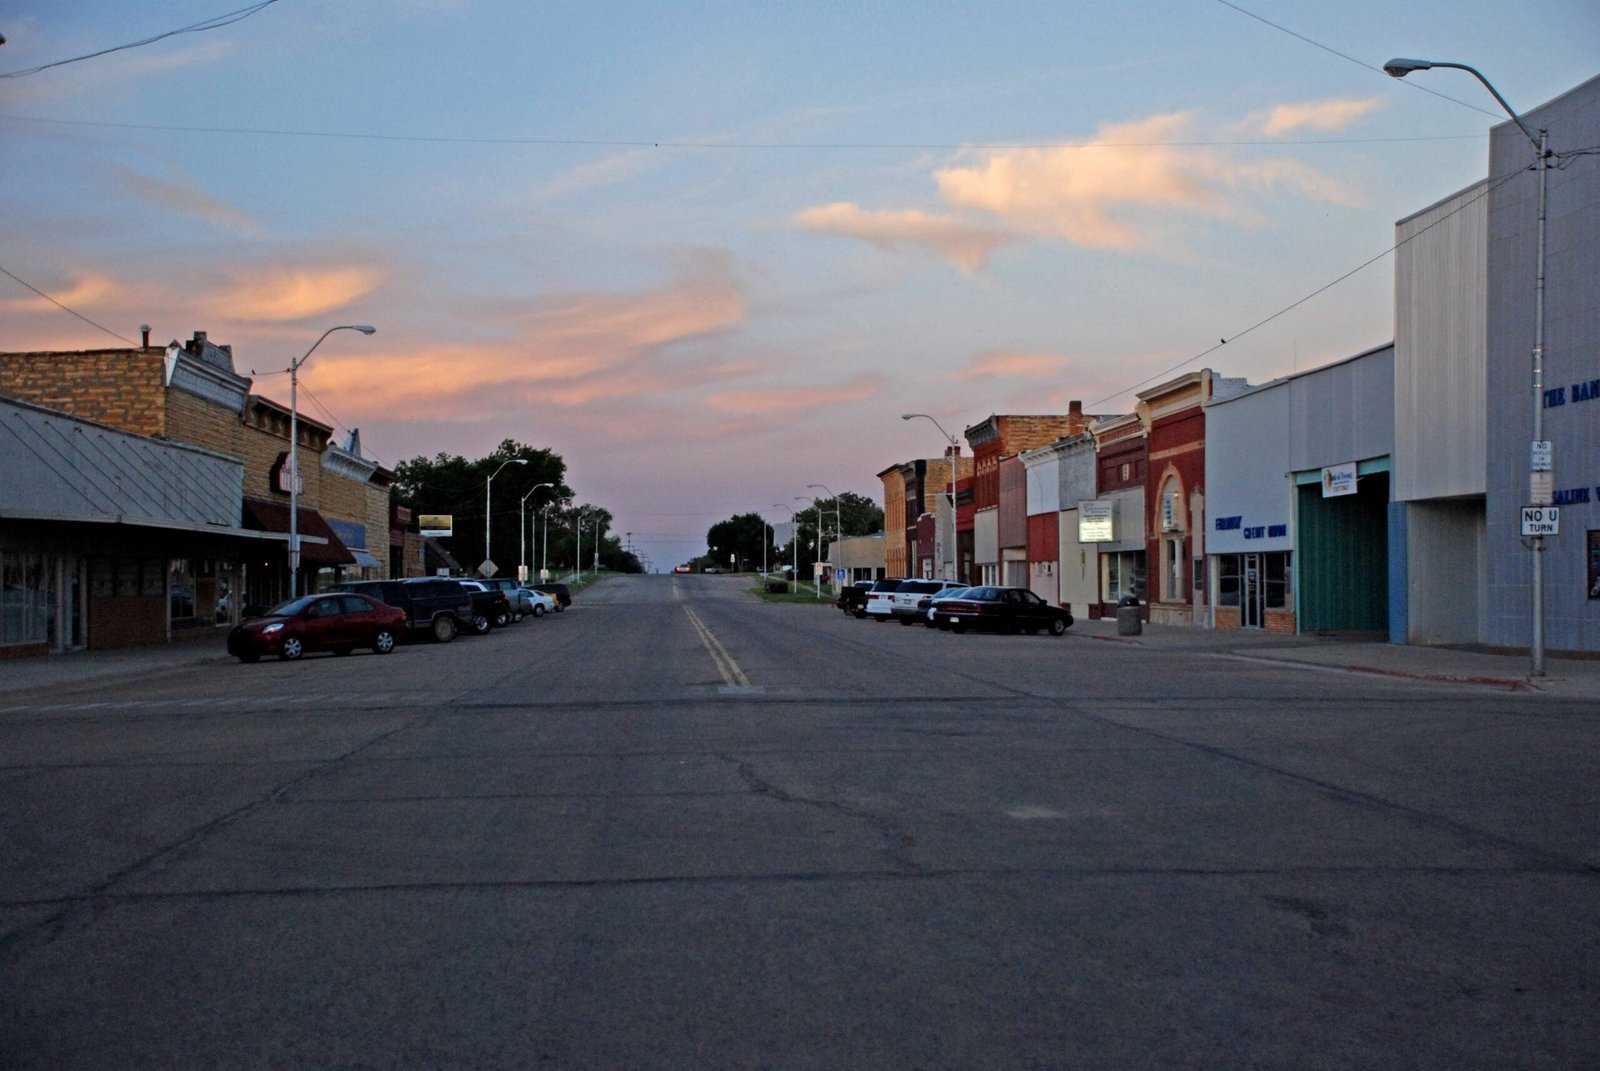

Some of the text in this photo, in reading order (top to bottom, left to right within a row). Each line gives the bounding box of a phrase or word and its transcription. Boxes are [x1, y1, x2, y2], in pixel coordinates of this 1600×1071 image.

[1524, 510, 1557, 522] NO U
[1529, 524, 1553, 532] TURN
